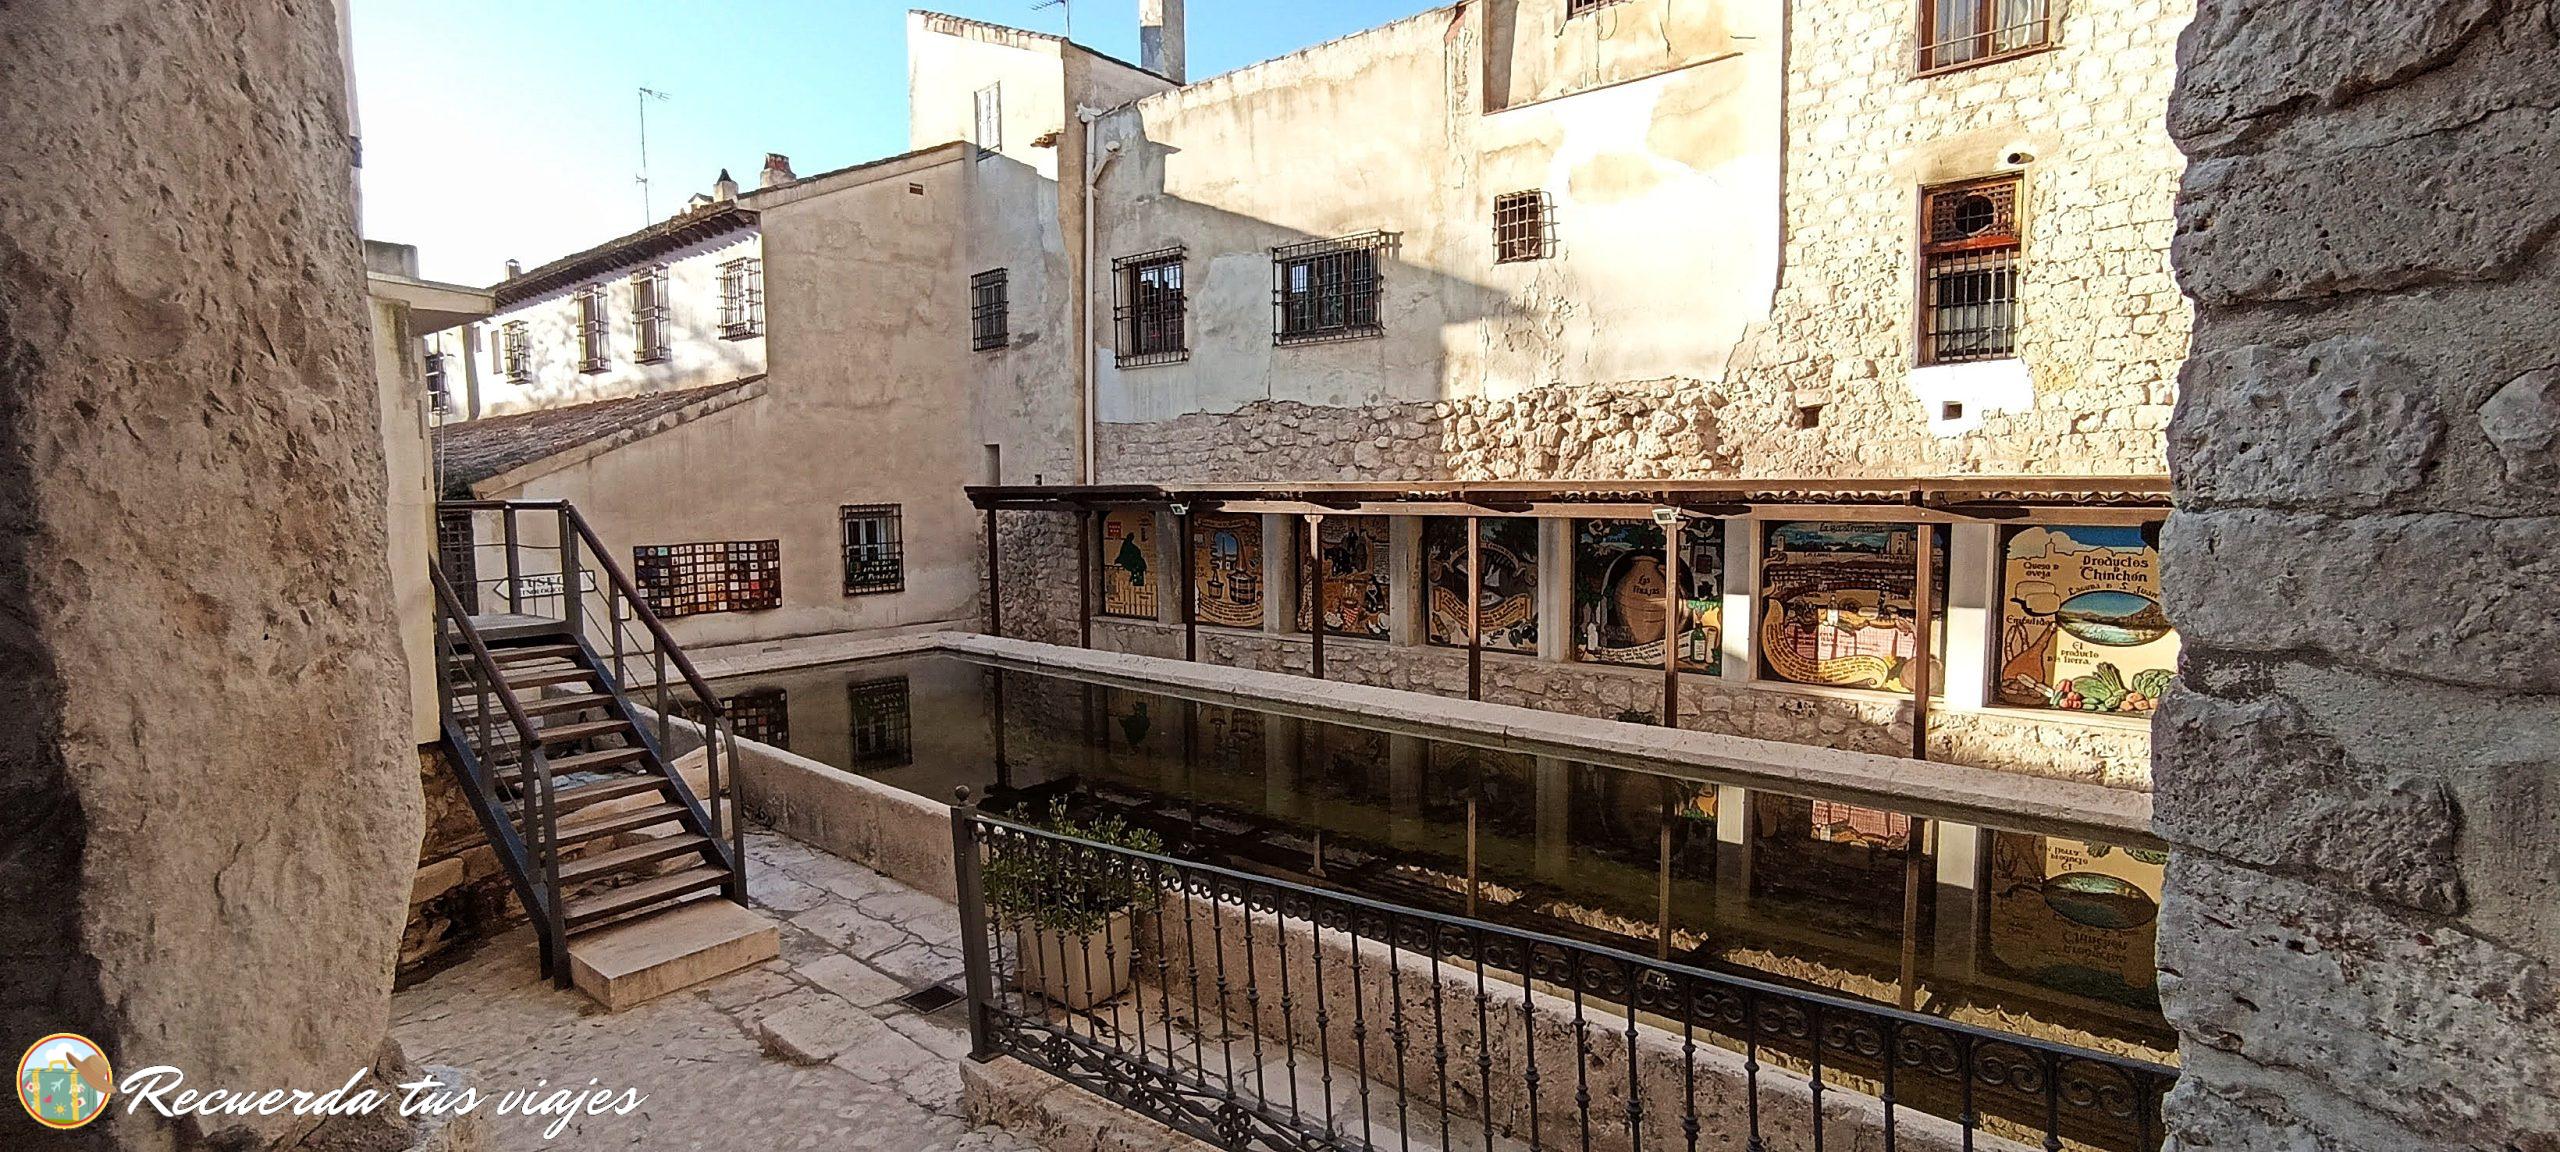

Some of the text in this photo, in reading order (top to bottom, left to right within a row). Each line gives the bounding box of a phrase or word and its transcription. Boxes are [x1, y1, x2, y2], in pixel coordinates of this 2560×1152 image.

[2023, 561, 2051, 570] Queso
[2083, 555, 2149, 568] Productos
[2025, 570, 2051, 579] oveja
[2080, 567, 2148, 582] Chinchón
[2072, 641, 2083, 650] El
[2061, 649, 2099, 659] producto
